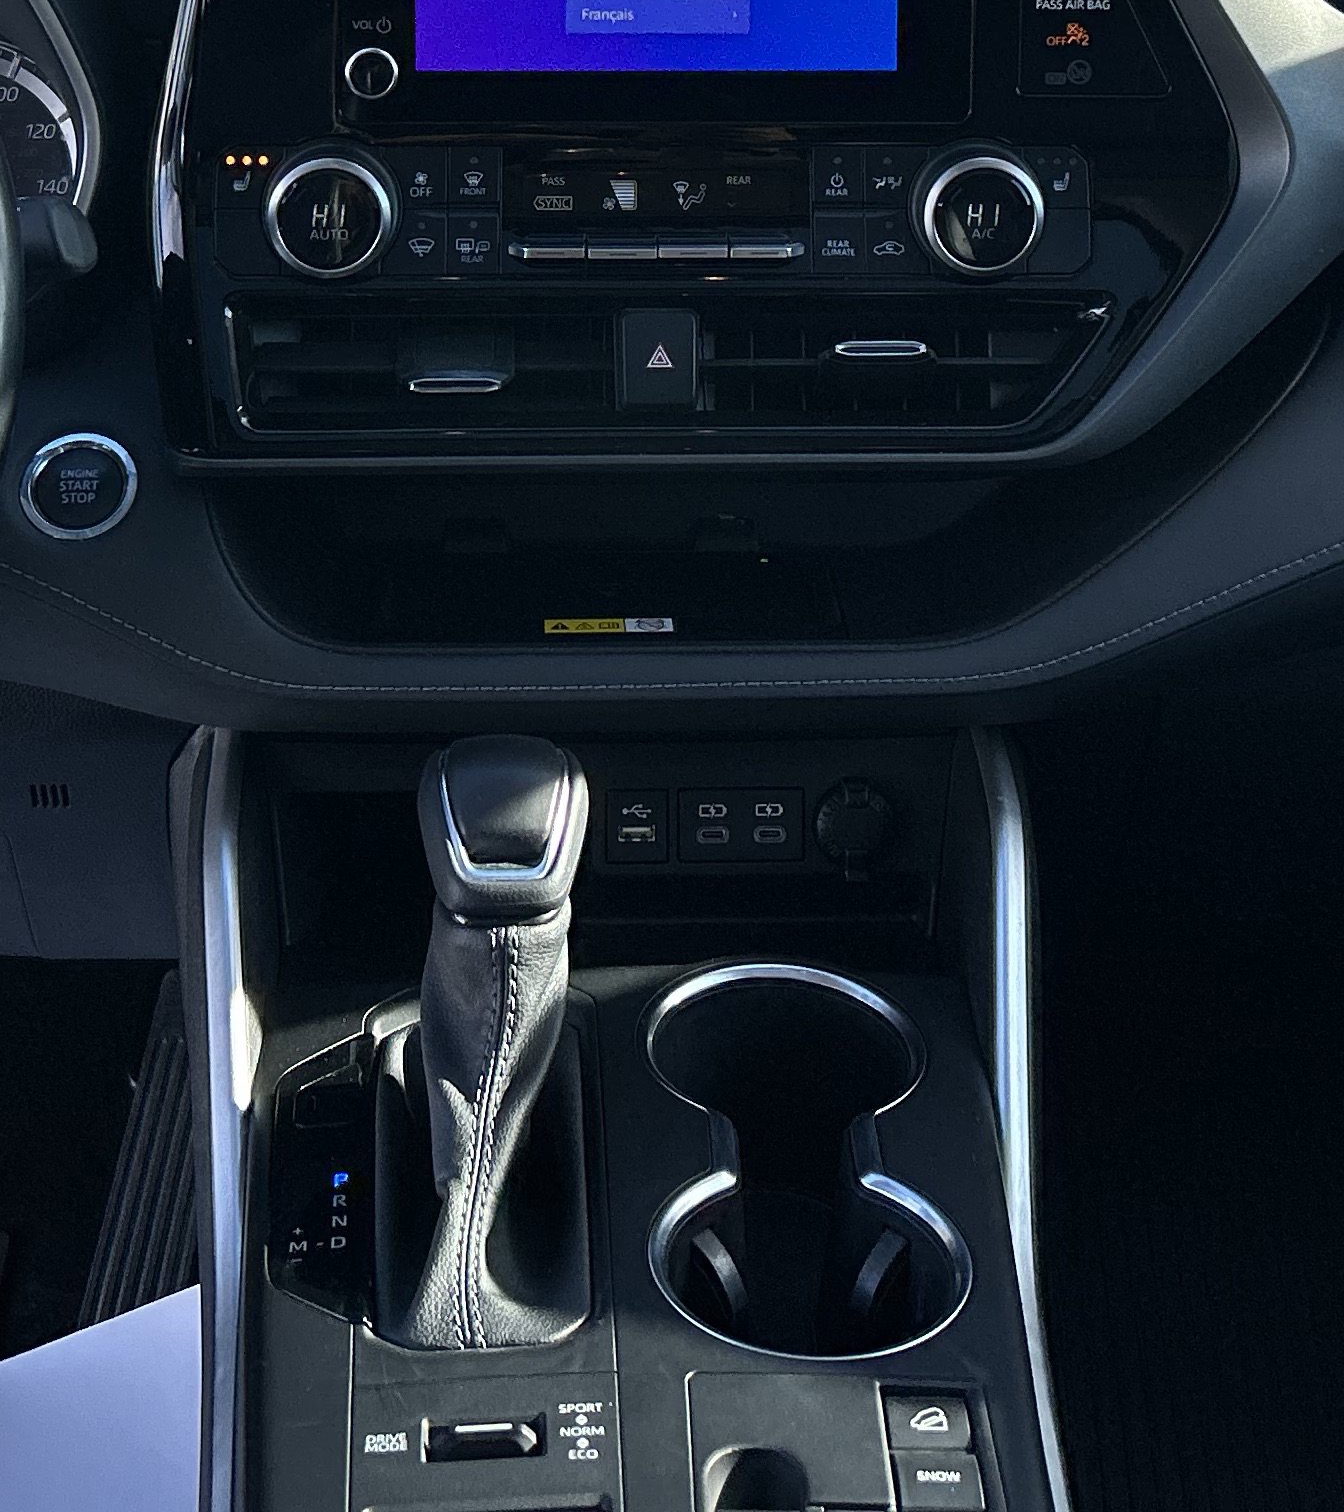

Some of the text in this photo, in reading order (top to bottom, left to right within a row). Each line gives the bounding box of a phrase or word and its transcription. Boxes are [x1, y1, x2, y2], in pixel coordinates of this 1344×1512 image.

[1035, 0, 1111, 11] PASS AIR BAG
[581, 7, 635, 25] Français
[351, 19, 374, 31] VOL
[1046, 35, 1068, 47] OFF
[25, 122, 56, 140] 120
[35, 177, 69, 195] 140
[541, 176, 565, 186] PASS
[726, 175, 752, 186] REAR
[409, 186, 433, 198] OFF
[459, 187, 487, 196] FRONT
[825, 188, 849, 197] REAR
[537, 198, 570, 209] SYNC
[311, 203, 346, 229] HI
[967, 203, 1000, 227] HI
[309, 228, 349, 242] AUTO
[971, 227, 995, 241] A/C
[826, 239, 851, 249] REAR
[460, 254, 484, 264] REAR
[821, 247, 856, 258] CLIMATE
[59, 467, 100, 480] ENGINE
[59, 479, 100, 492] START
[60, 491, 96, 505] STOP
[332, 1171, 350, 1189] P
[332, 1194, 347, 1208] R
[330, 1214, 348, 1229] N
[288, 1236, 347, 1253] M D
[558, 1401, 603, 1415] SPORT
[559, 1424, 606, 1437] NORM
[364, 1432, 408, 1445] DRIVE
[364, 1441, 408, 1454] MODE
[567, 1448, 599, 1461] ECO
[915, 1470, 961, 1485] SNOW
